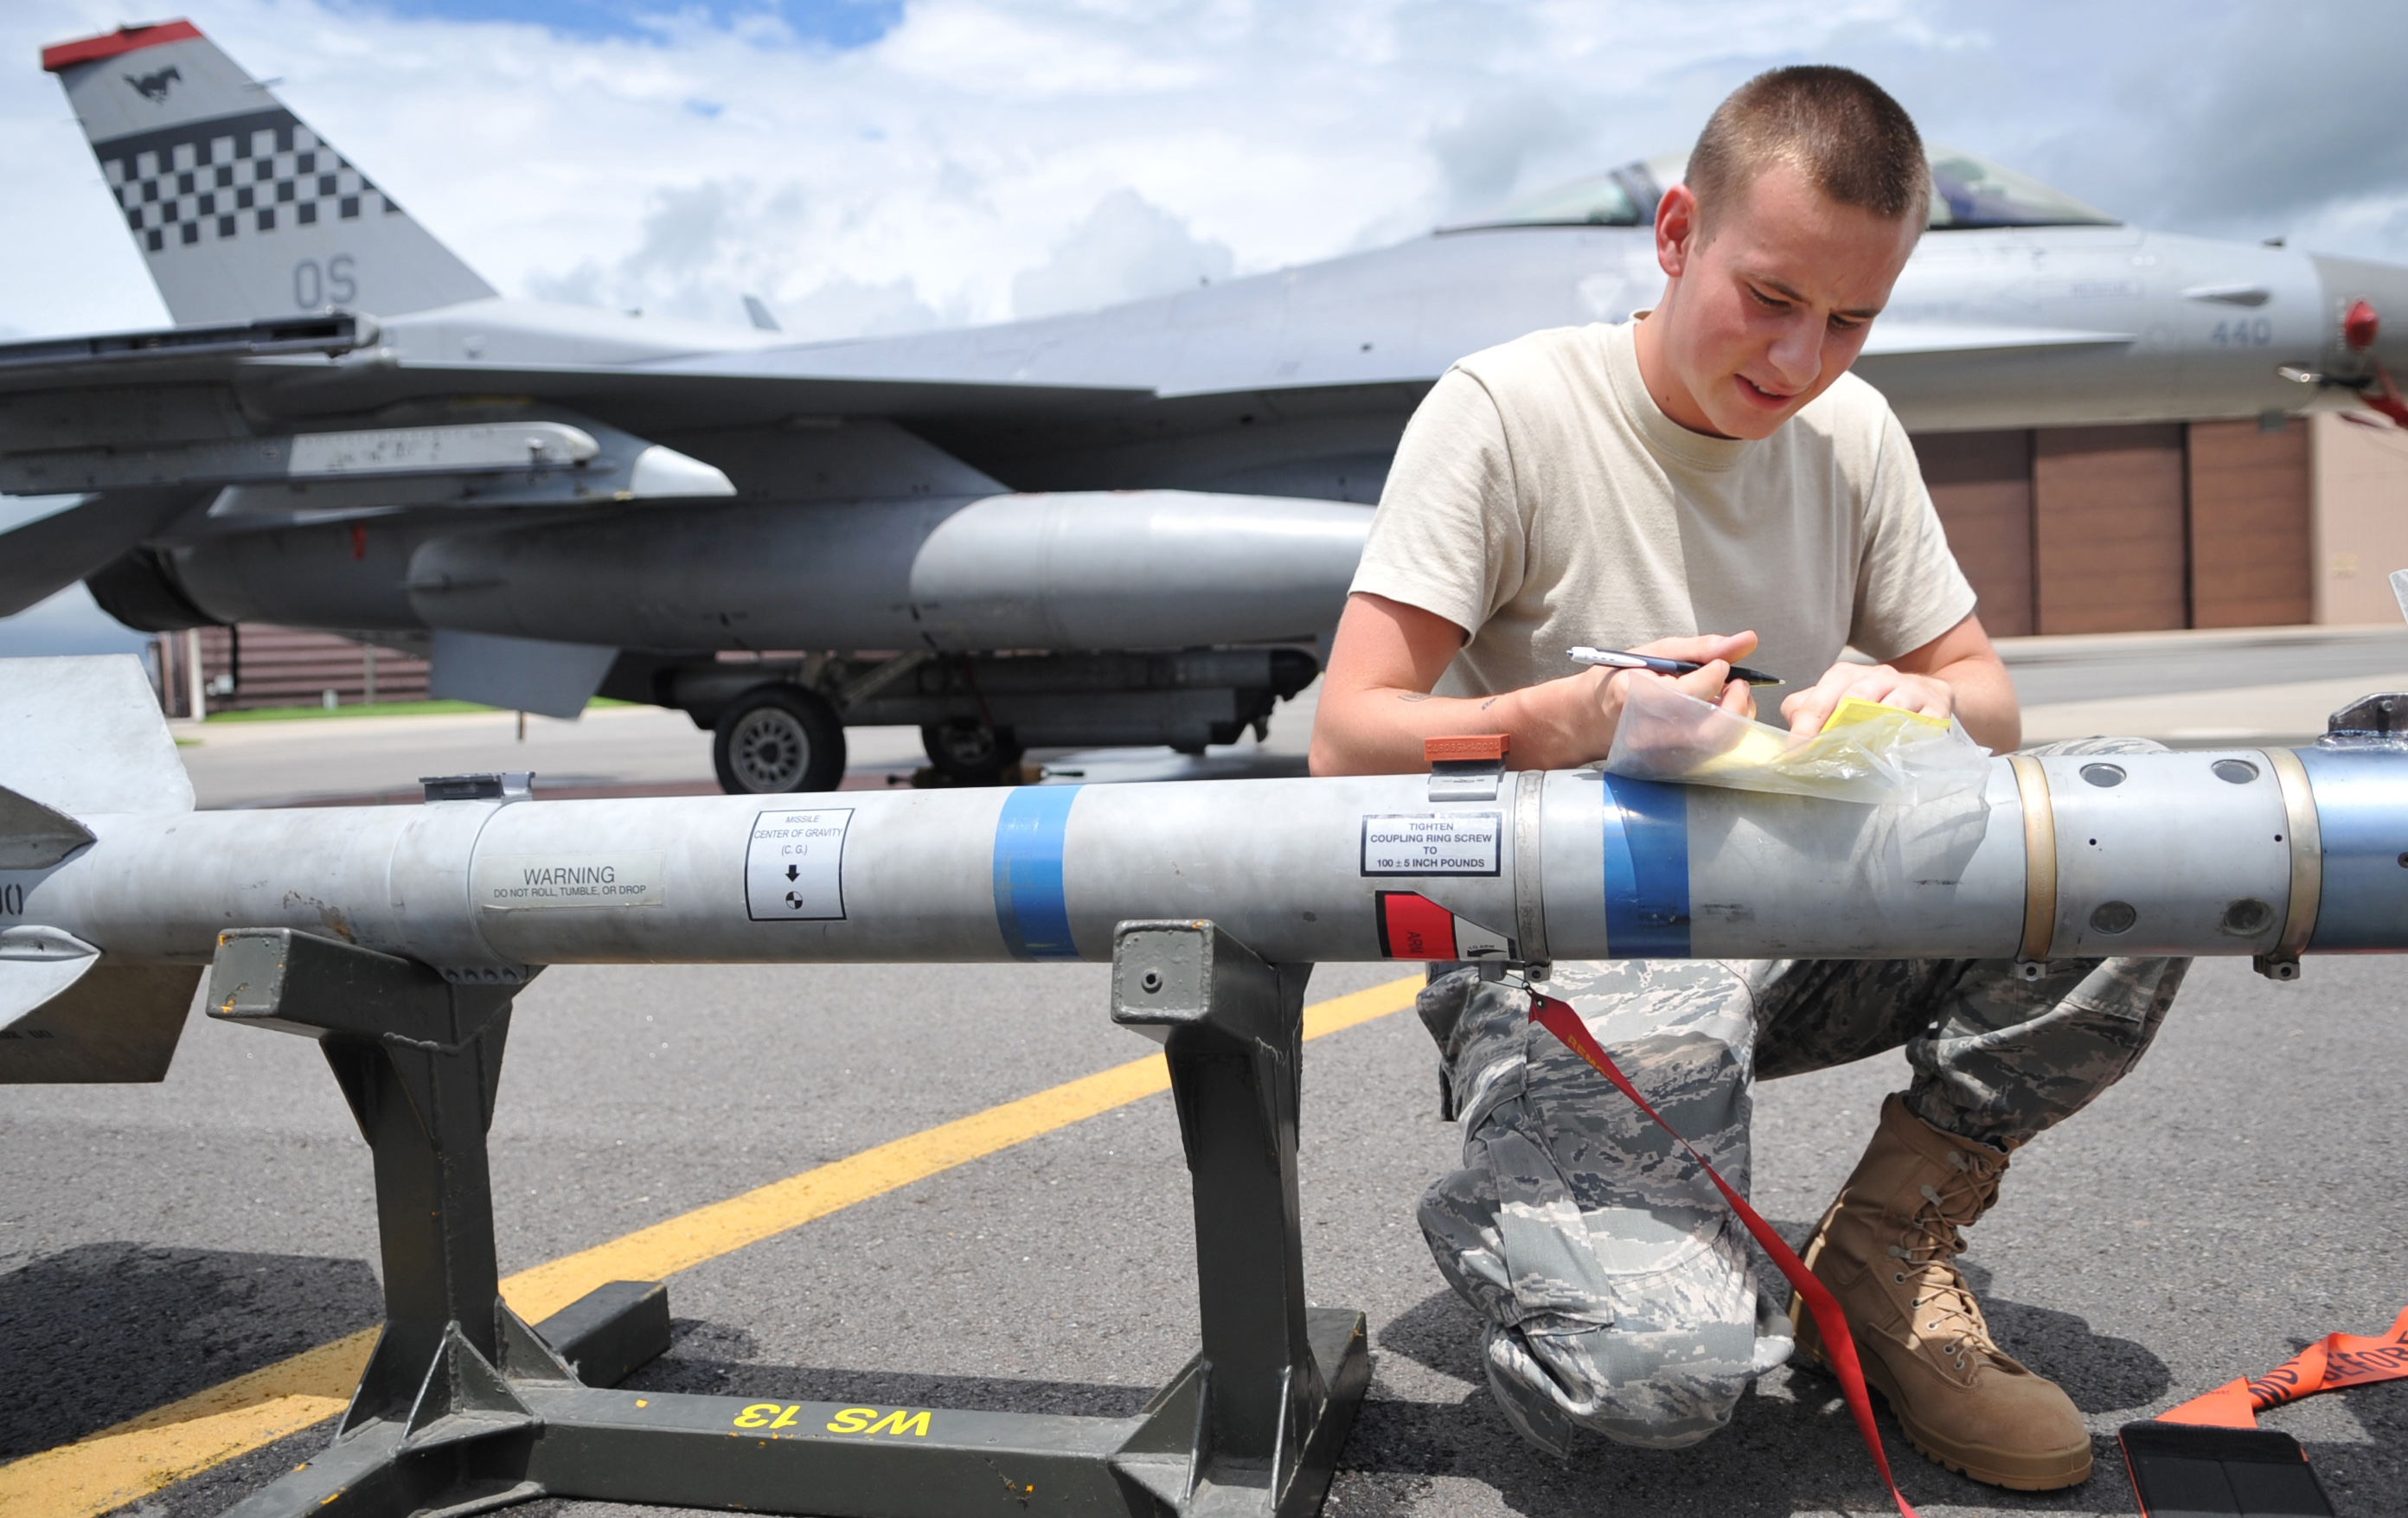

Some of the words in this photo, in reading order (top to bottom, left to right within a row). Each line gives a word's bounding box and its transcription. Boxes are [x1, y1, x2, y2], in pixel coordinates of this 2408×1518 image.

[785, 815, 820, 823] MISSILE
[1409, 823, 1454, 831] TIGHTEN
[753, 829, 789, 839] CENTER
[791, 829, 804, 837] OF
[805, 828, 843, 837] GRAVITY
[1370, 835, 1424, 843] COUPLING
[1454, 834, 1492, 842] SCREW
[1423, 846, 1438, 855] TO
[1377, 859, 1393, 868] 100
[1404, 859, 1410, 868] 5
[1412, 859, 1438, 868] INCH
[1440, 859, 1485, 868] POUNDS
[524, 866, 615, 886] WARNING
[494, 888, 508, 898] DO
[510, 888, 528, 897] NOT
[531, 887, 558, 898] ROLL,
[560, 886, 600, 897] TUMBLE,
[602, 886, 617, 895] OR
[619, 884, 646, 894] DROP
[1407, 930, 1424, 954] ARM
[733, 1403, 801, 1429] 13
[827, 1407, 932, 1437] WS
